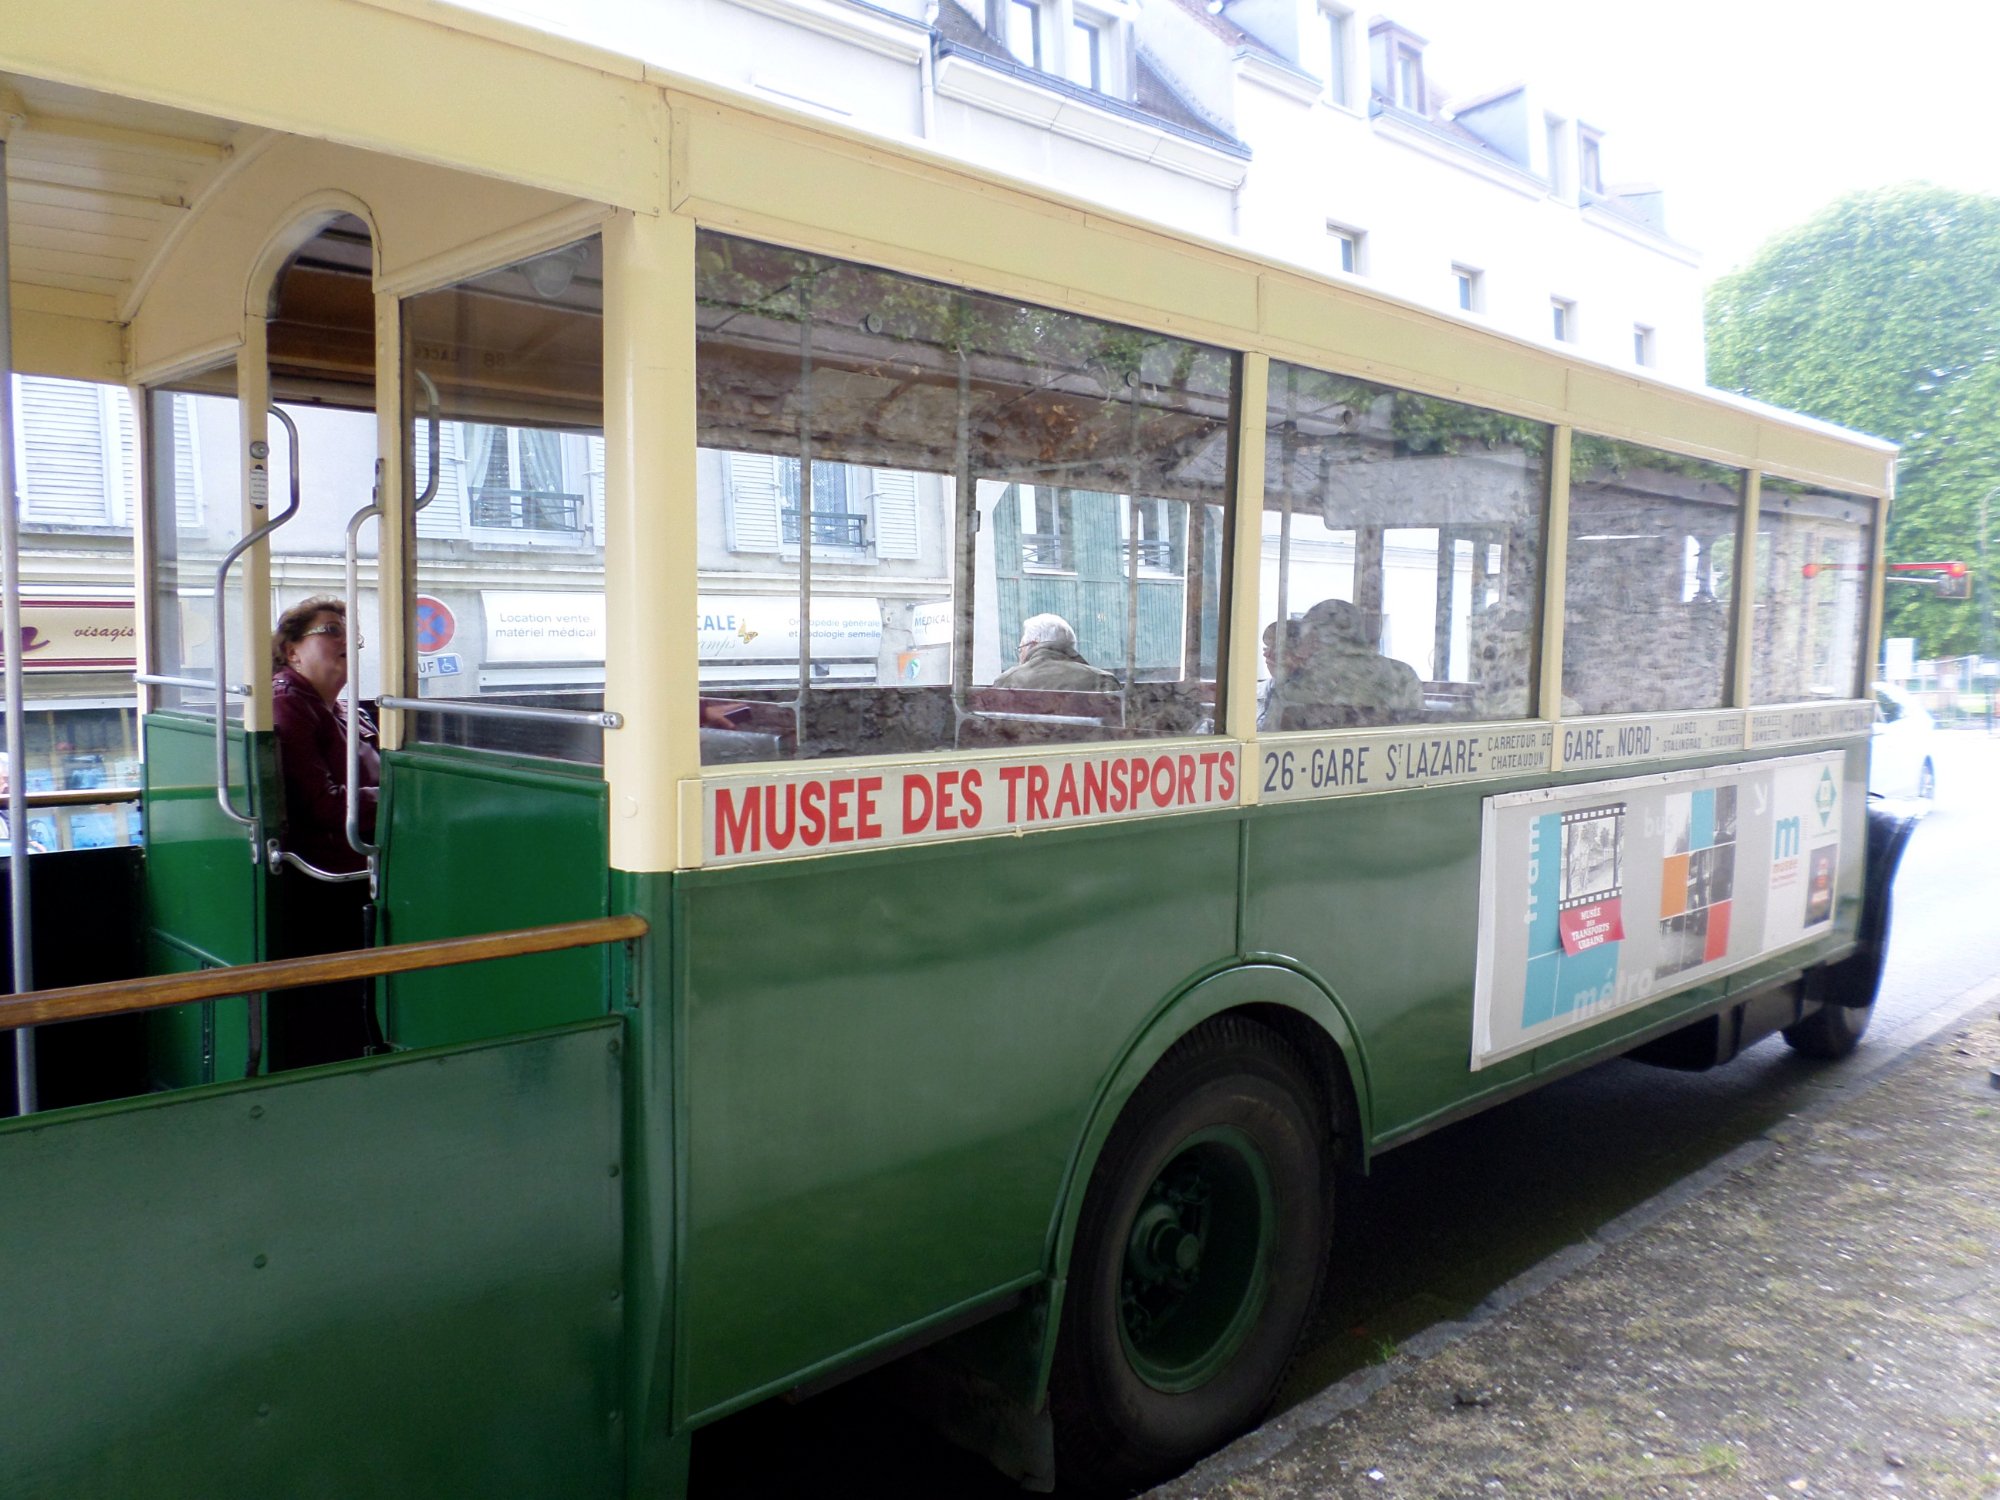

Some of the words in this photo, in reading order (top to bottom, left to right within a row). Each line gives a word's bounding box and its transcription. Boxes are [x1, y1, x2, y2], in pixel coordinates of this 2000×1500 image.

[499, 613, 552, 623] Location
[556, 614, 591, 623] vente
[914, 613, 952, 627] MEDICAL
[74, 626, 135, 642] visagis
[789, 630, 798, 638] et
[810, 630, 846, 641] odologie
[847, 630, 881, 638] semelle
[418, 661, 434, 674] UF
[1487, 733, 1536, 752] CARREFOUR
[1541, 732, 1553, 747] DE
[1563, 728, 1604, 763] GARE
[1605, 745, 1615, 758] DU
[1617, 725, 1652, 757] NORD
[1264, 750, 1295, 792] 26
[1311, 746, 1370, 789] GARE
[1491, 751, 1545, 770] CHATEAUDUN
[714, 776, 883, 857] MUSEE
[902, 768, 983, 835] DES
[999, 750, 1236, 823] TRANSPORTS
[1643, 806, 1675, 839] bus
[1774, 815, 1800, 861] m
[1523, 815, 1541, 925] tram
[1571, 922, 1610, 942] TRANSPORTS
[1578, 934, 1604, 950] URBAINS
[1573, 967, 1656, 1023] métro
